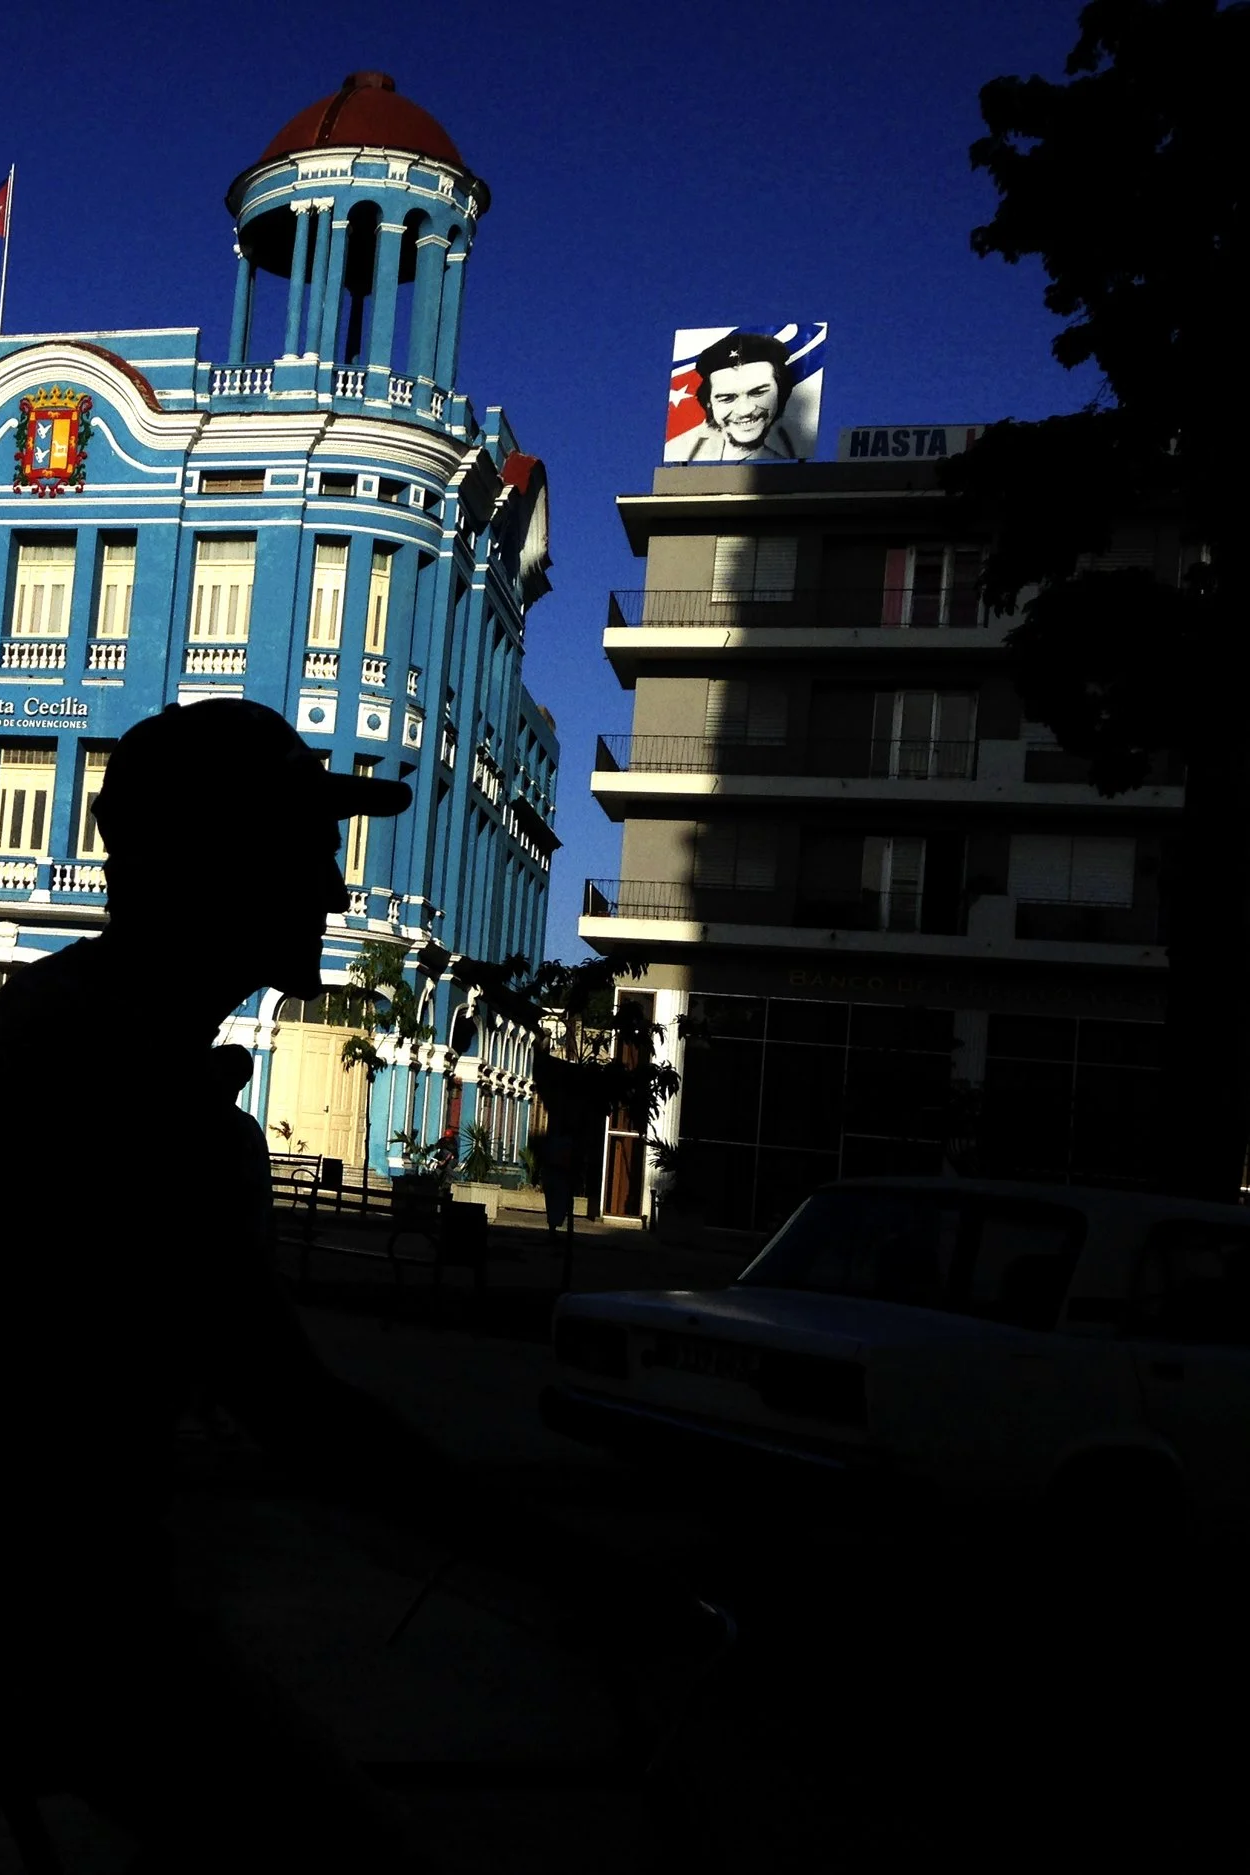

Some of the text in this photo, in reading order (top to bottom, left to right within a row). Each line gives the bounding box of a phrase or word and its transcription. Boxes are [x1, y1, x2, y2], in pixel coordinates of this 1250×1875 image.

[850, 429, 947, 457] HASTA
[23, 697, 88, 717] Cecilia
[3, 718, 15, 727] DE
[16, 719, 88, 729] CONVENCIONES
[788, 969, 884, 990] BANCO
